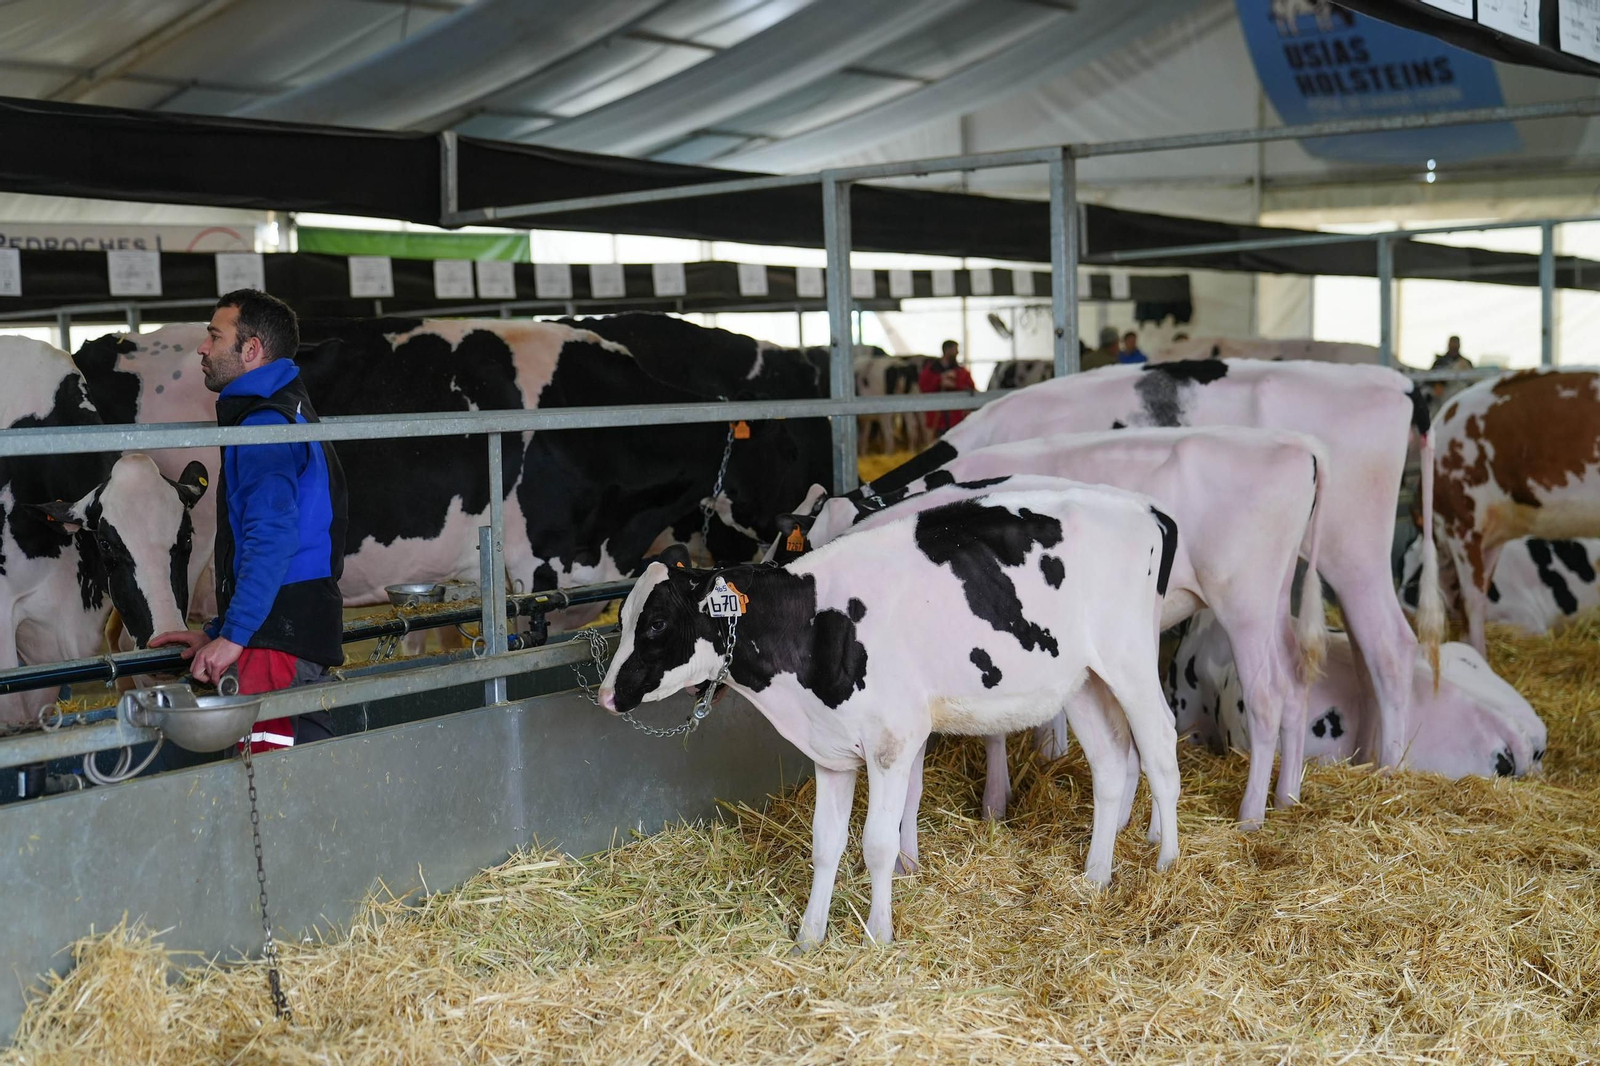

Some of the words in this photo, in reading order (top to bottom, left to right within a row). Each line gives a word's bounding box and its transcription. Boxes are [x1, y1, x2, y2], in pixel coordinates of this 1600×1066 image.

[1283, 35, 1370, 70] USIAS
[1294, 55, 1455, 97] HOLSTEINS
[710, 595, 738, 612] 670
